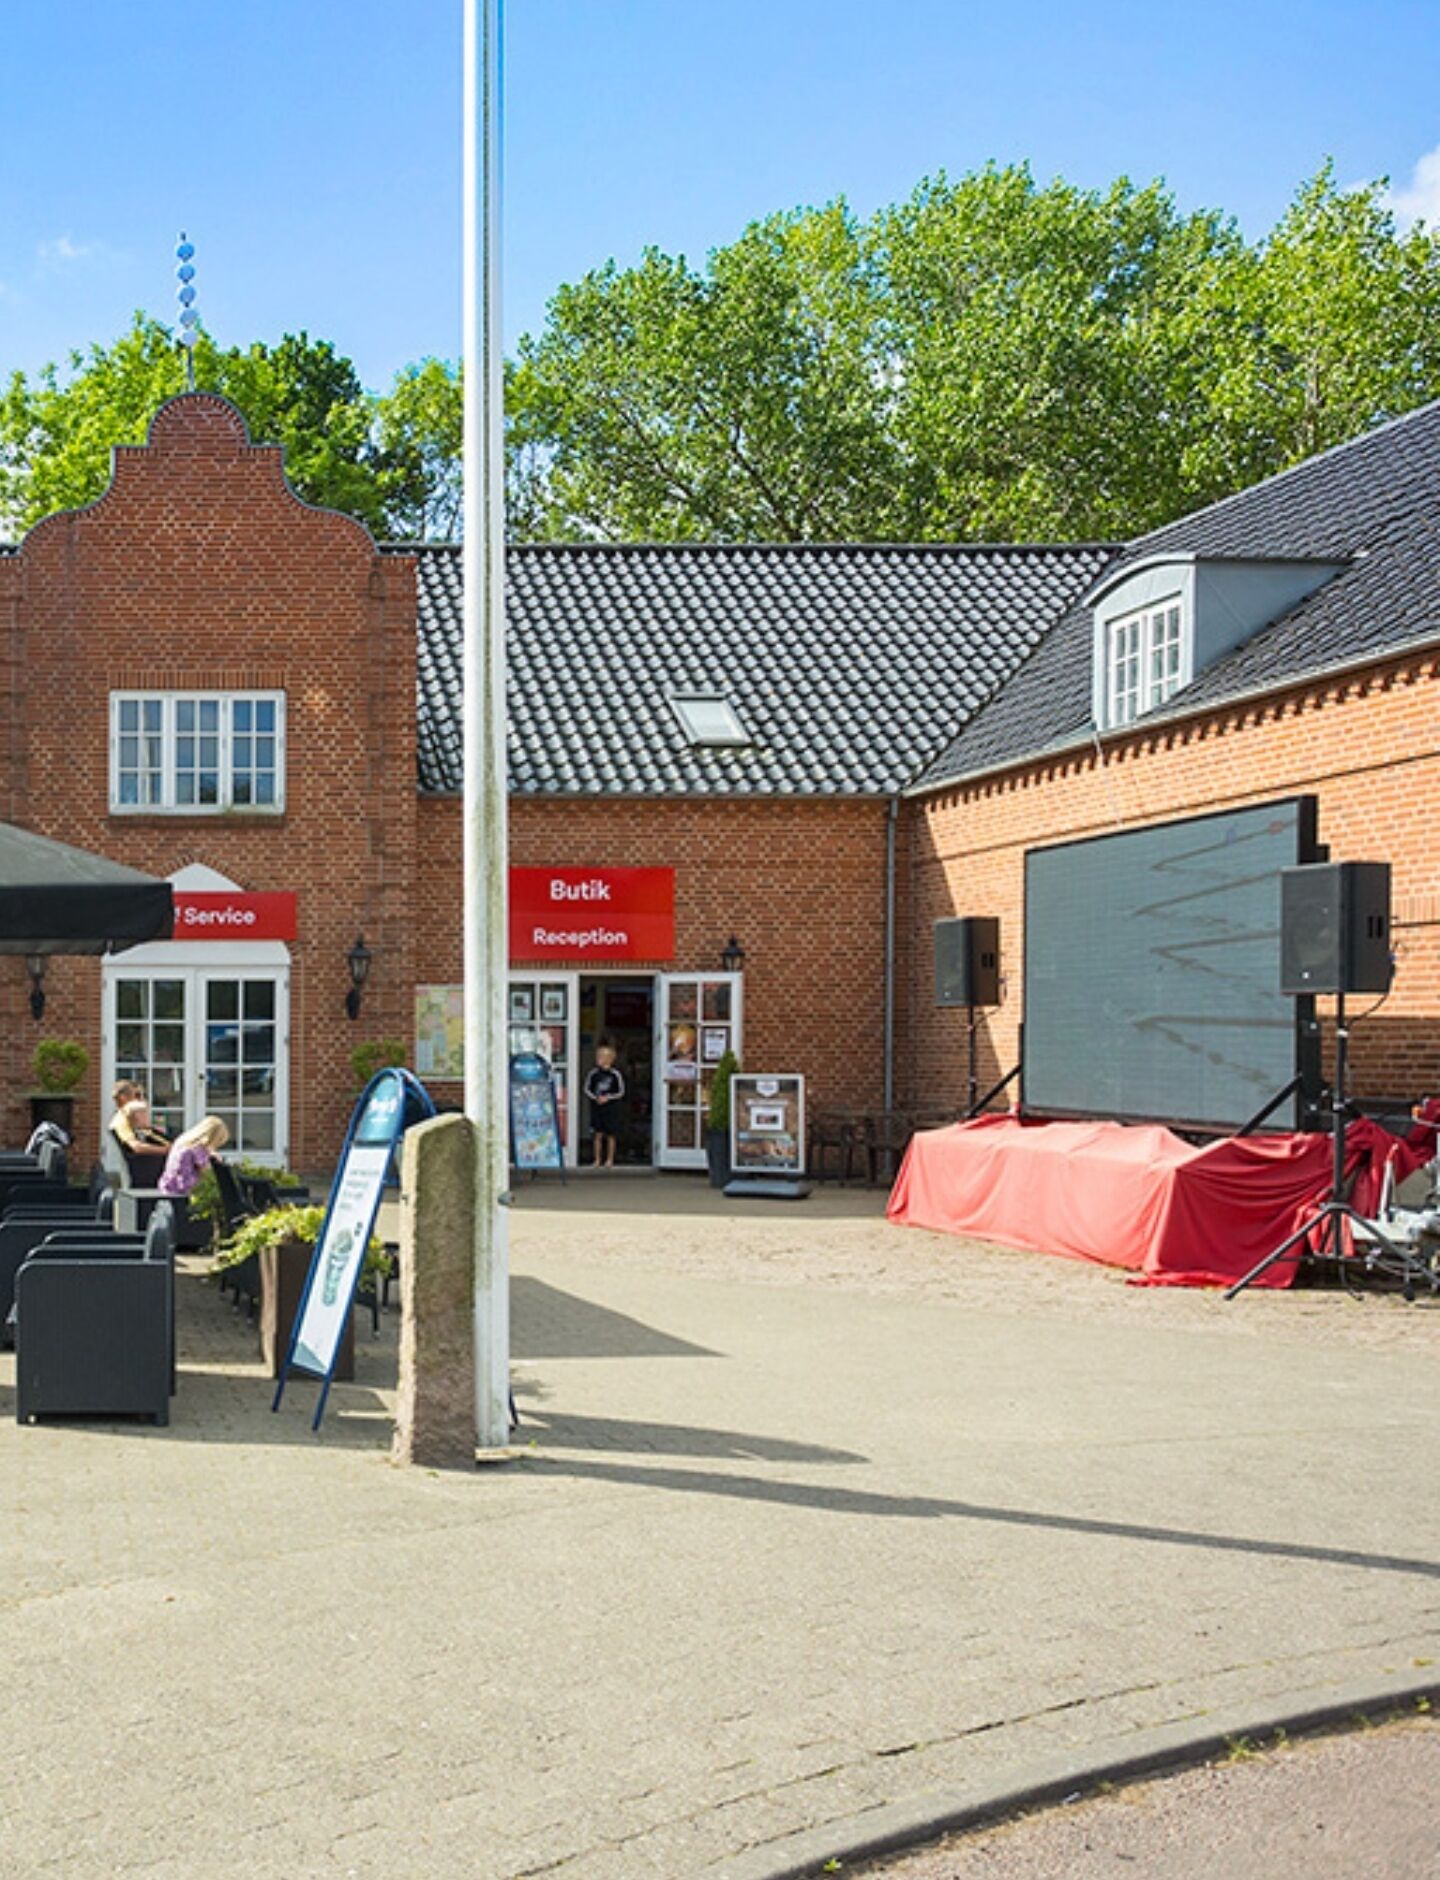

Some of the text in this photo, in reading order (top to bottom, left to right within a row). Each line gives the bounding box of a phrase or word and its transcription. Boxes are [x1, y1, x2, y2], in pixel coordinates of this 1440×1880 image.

[550, 879, 611, 901] Butik
[184, 906, 255, 925] Service
[533, 927, 628, 949] Reception
